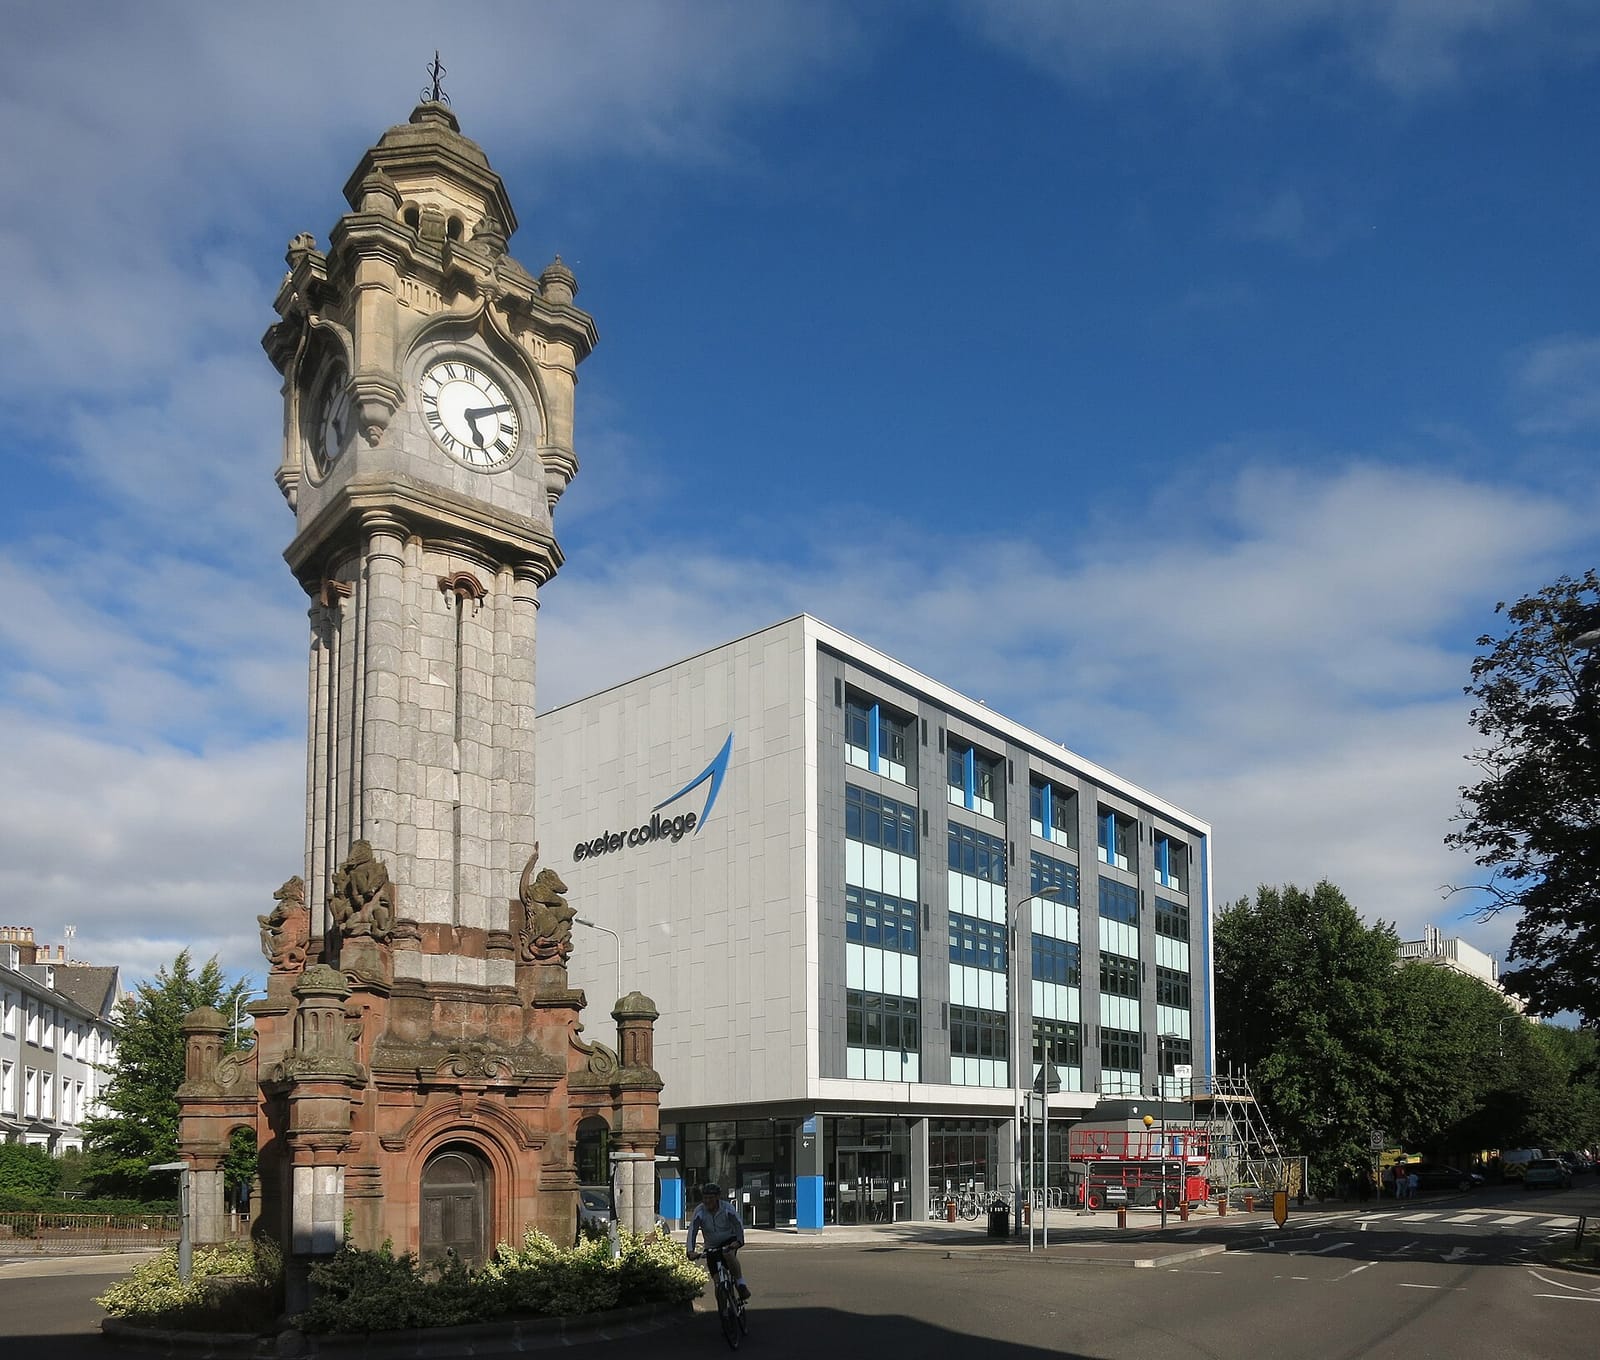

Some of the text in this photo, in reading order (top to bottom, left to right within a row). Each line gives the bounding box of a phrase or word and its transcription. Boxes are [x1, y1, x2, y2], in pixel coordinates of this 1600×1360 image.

[428, 373, 443, 388] X
[464, 365, 475, 383] XII
[573, 812, 697, 863] exeter college
